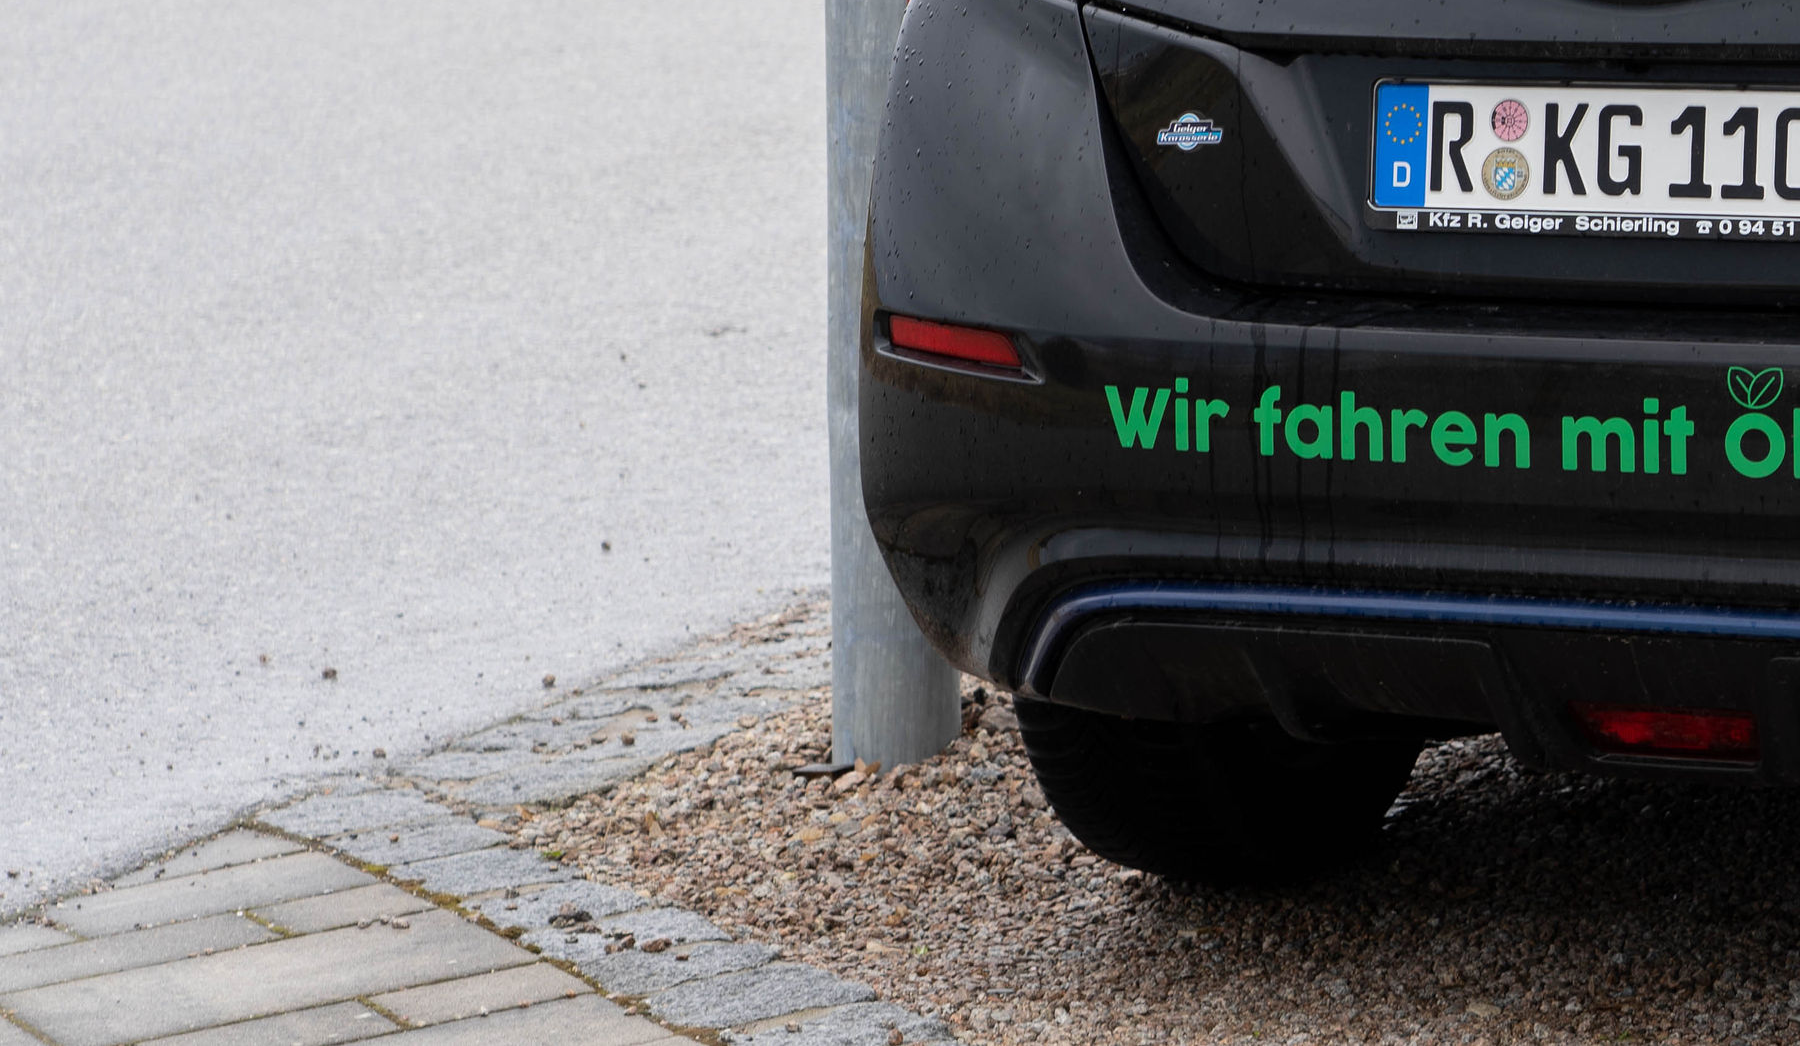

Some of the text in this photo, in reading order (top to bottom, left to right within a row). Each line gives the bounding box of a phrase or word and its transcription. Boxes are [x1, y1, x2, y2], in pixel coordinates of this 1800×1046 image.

[1391, 160, 1411, 188] D
[1429, 100, 1474, 192] R
[1542, 102, 1643, 196] KG
[1429, 211, 1461, 229] Kfz
[1467, 213, 1488, 229] R.
[1494, 213, 1563, 233] Geiger
[1575, 215, 1680, 237] Schierling
[1718, 220, 1733, 235] 0
[1738, 220, 1765, 236] 94
[1771, 221, 1796, 236] 51
[1104, 377, 1231, 453] Wir
[1253, 385, 1531, 469] fahren
[1561, 397, 1695, 475] mit
